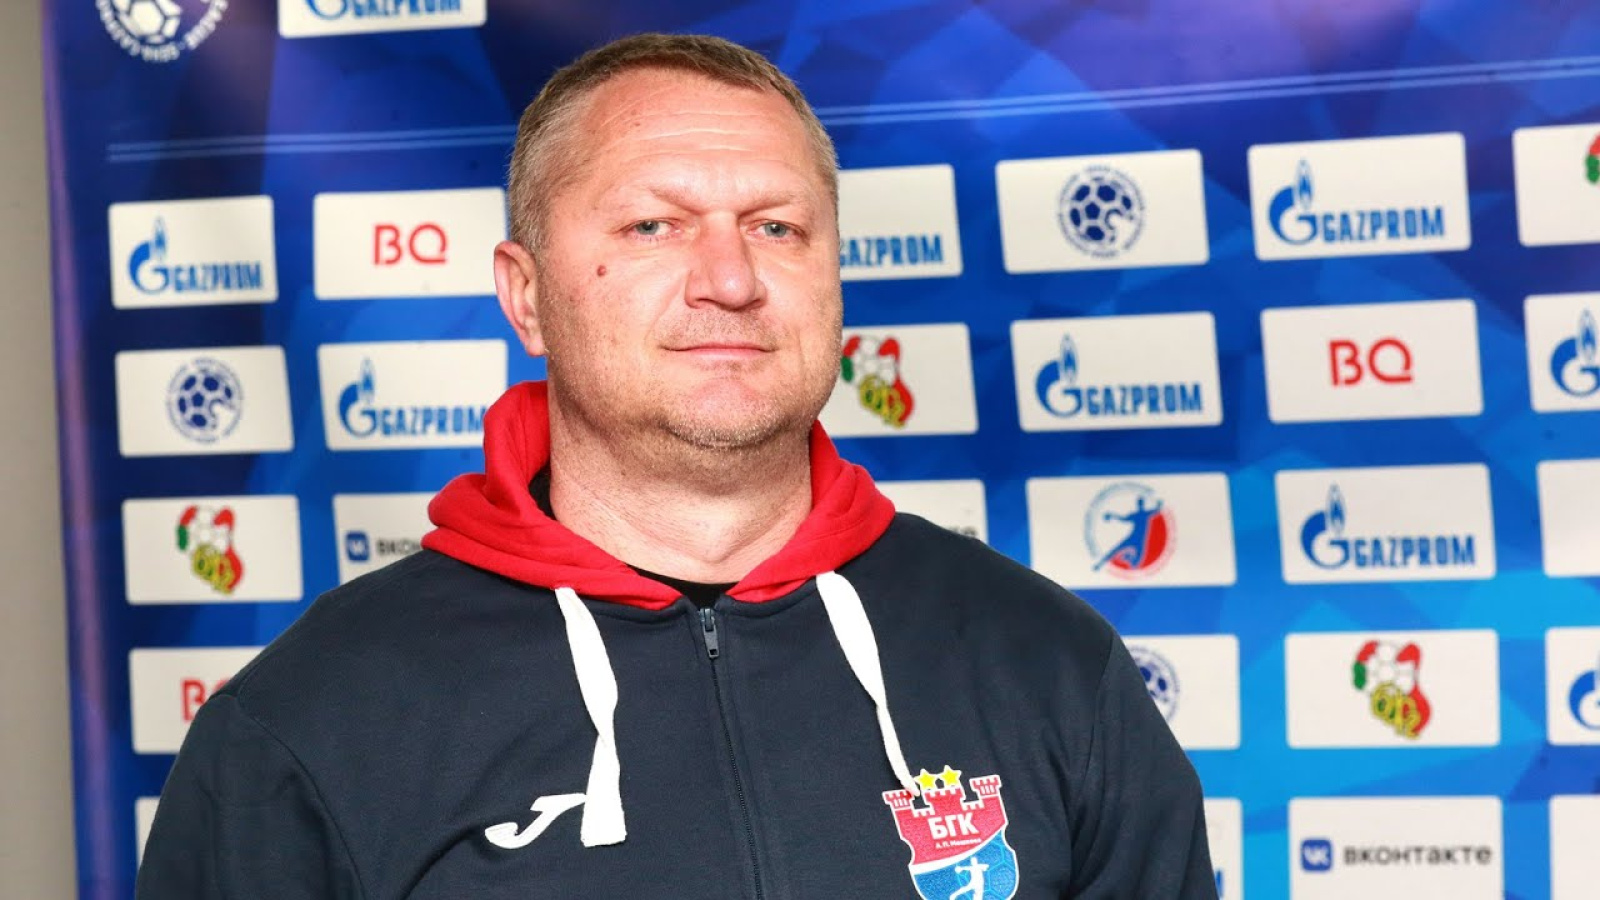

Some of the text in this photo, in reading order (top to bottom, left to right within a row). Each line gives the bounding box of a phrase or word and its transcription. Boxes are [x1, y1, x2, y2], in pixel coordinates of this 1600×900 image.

[1322, 207, 1444, 243] GAZPROM
[372, 223, 448, 266] BQ
[174, 262, 262, 292] GAZPROM
[1328, 337, 1413, 386] BQ
[1086, 383, 1202, 415] GAZPROM
[1354, 535, 1475, 568] GAZPROM
[928, 813, 979, 839] БГК
